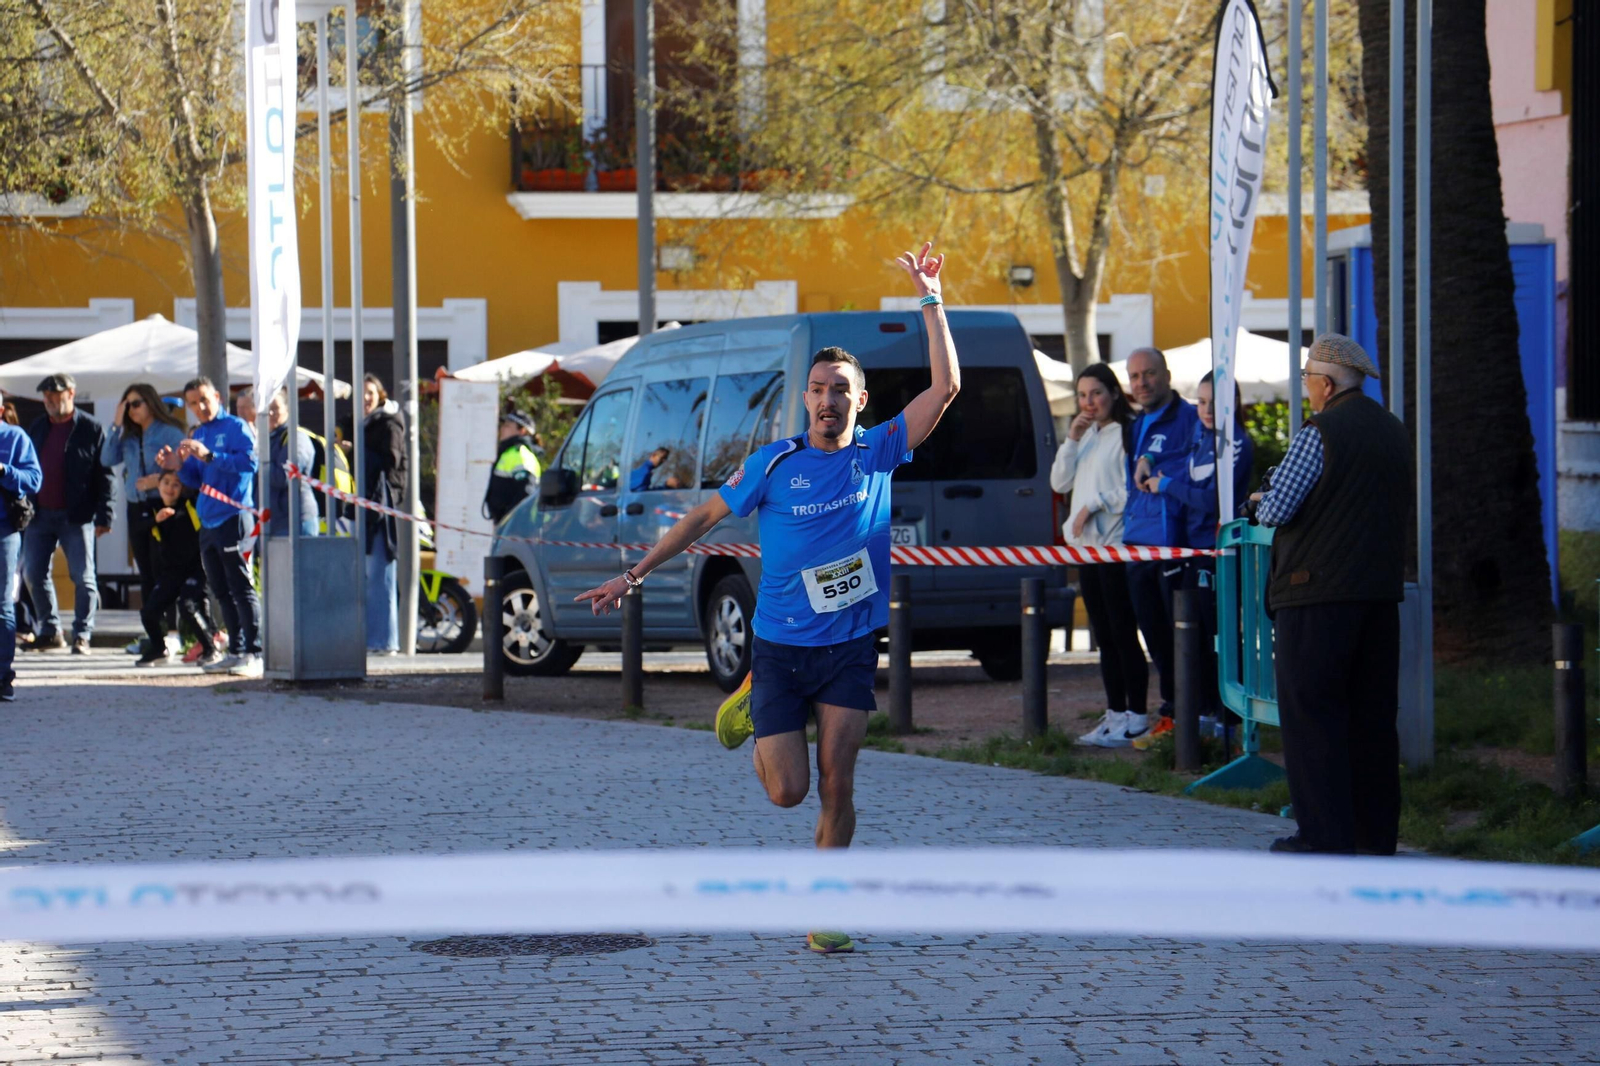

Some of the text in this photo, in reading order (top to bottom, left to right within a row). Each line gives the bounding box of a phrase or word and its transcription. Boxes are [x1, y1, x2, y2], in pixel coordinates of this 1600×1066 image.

[791, 488, 870, 516] TROTASIERRA
[892, 527, 911, 545] ZG
[823, 575, 861, 599] 530
